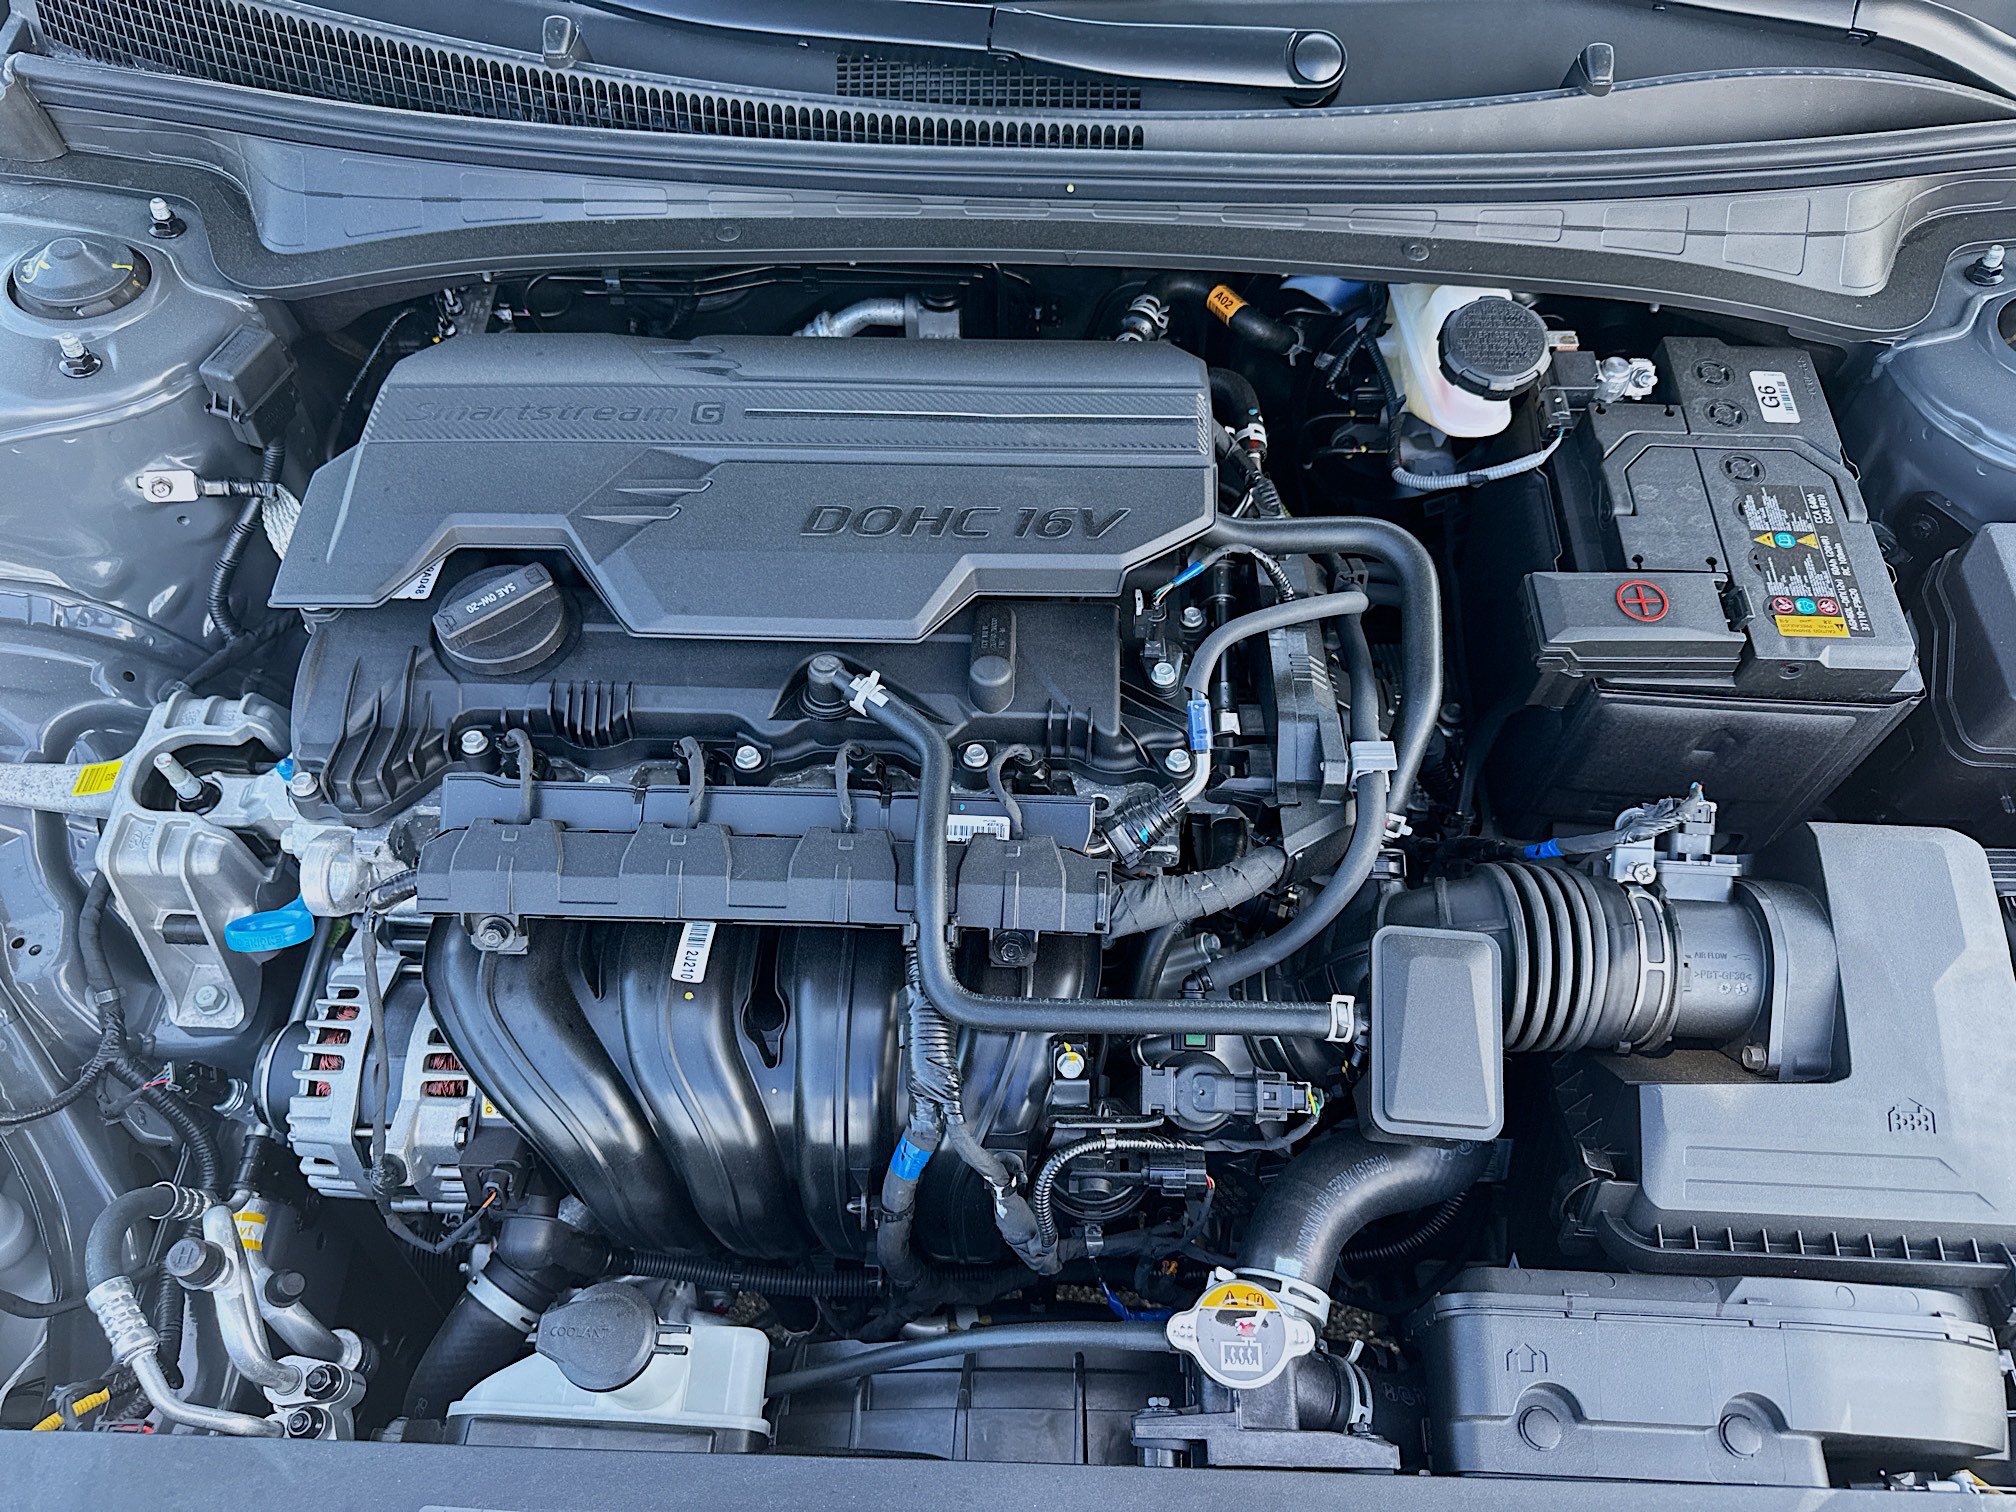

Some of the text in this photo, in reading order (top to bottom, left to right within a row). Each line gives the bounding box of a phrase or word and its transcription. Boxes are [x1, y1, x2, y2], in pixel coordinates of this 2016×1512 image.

[1213, 291, 1234, 310] A02
[1757, 385, 1781, 408] G6
[405, 401, 679, 424] Smartstream
[800, 504, 1132, 539] DOHC 16V
[466, 583, 517, 614] SAE 0W-20
[680, 950, 699, 980] 2J210
[1694, 951, 1728, 960] AIR FLOW
[177, 1246, 194, 1264] H
[550, 1326, 609, 1339] COOLANT
